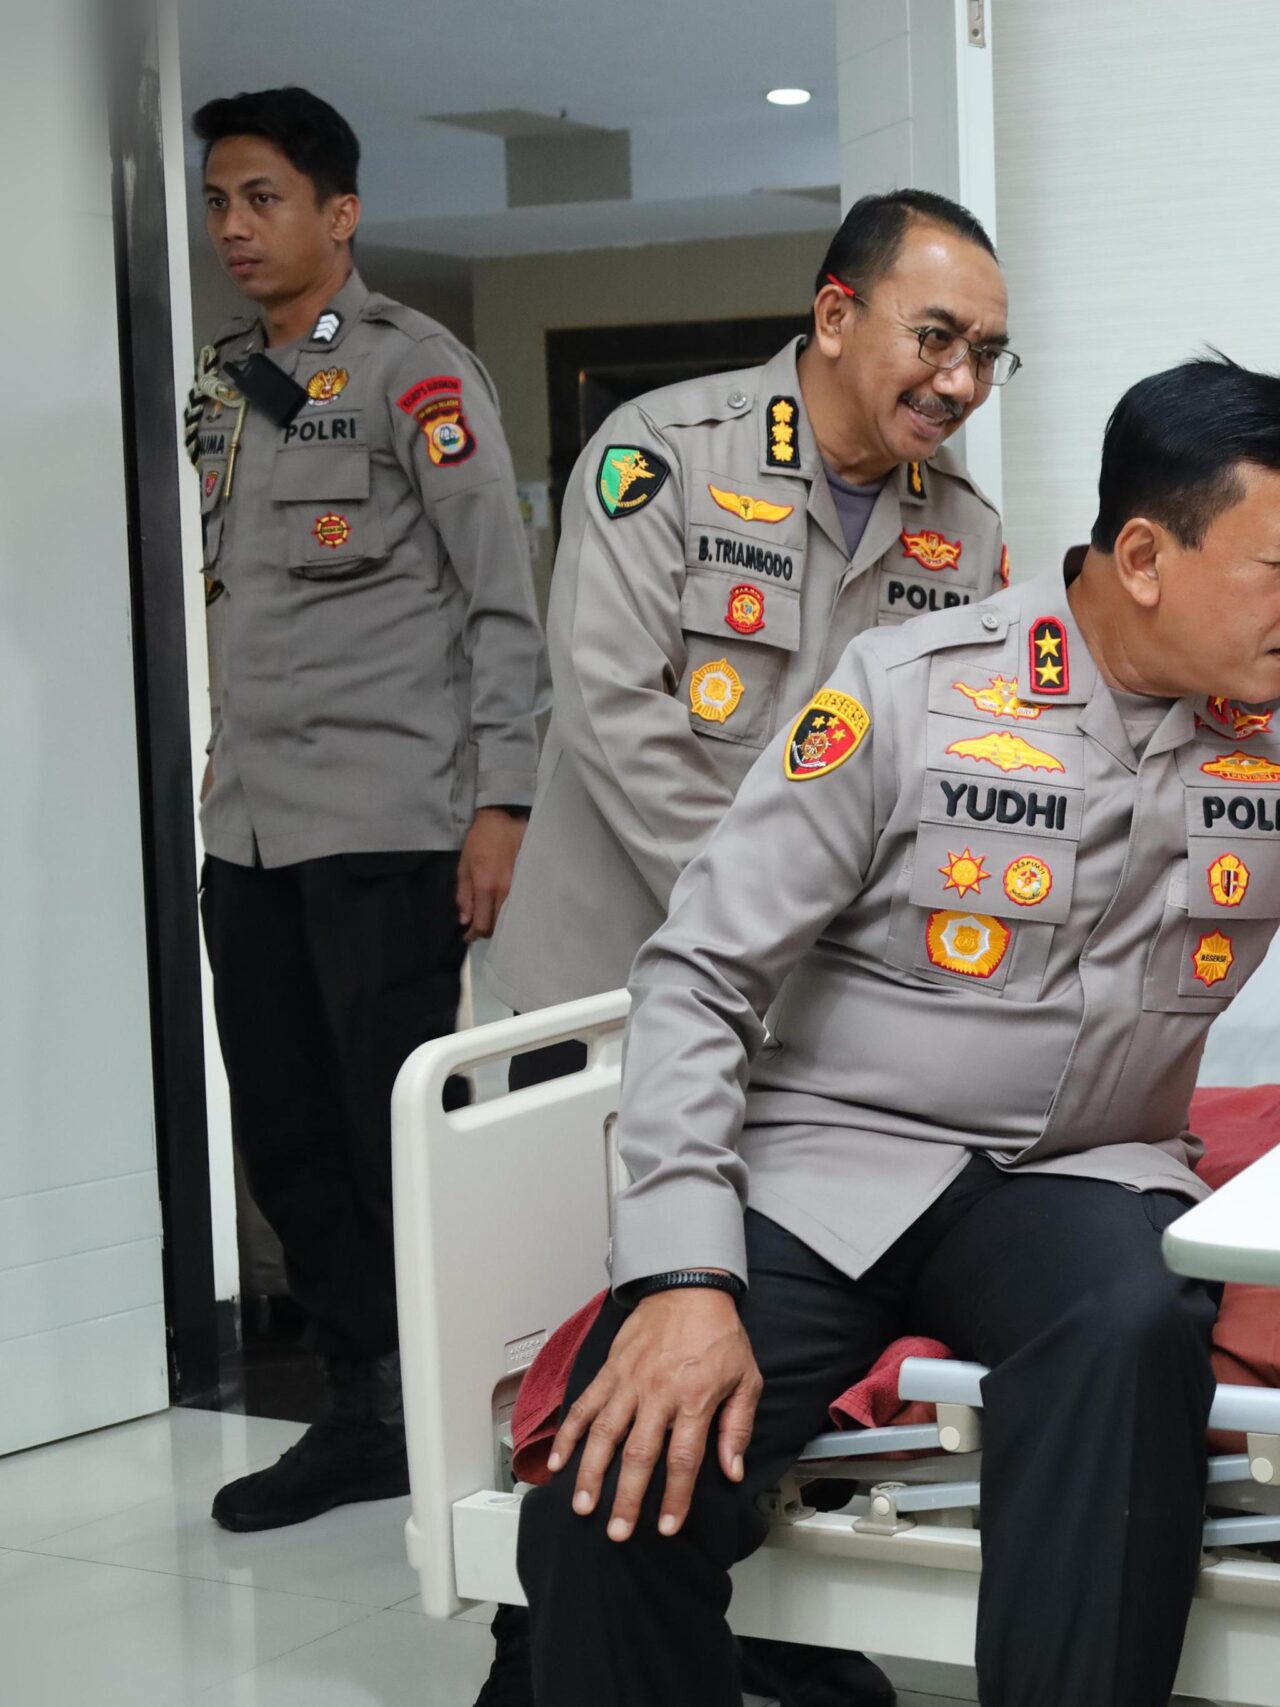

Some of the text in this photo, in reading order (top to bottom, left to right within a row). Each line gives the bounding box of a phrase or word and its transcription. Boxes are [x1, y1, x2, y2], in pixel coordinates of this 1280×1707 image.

[284, 417, 357, 444] POLRI
[698, 535, 793, 581] B. TRIAMBODO
[815, 693, 866, 732] RESERSE
[940, 780, 1067, 831] YUDHI
